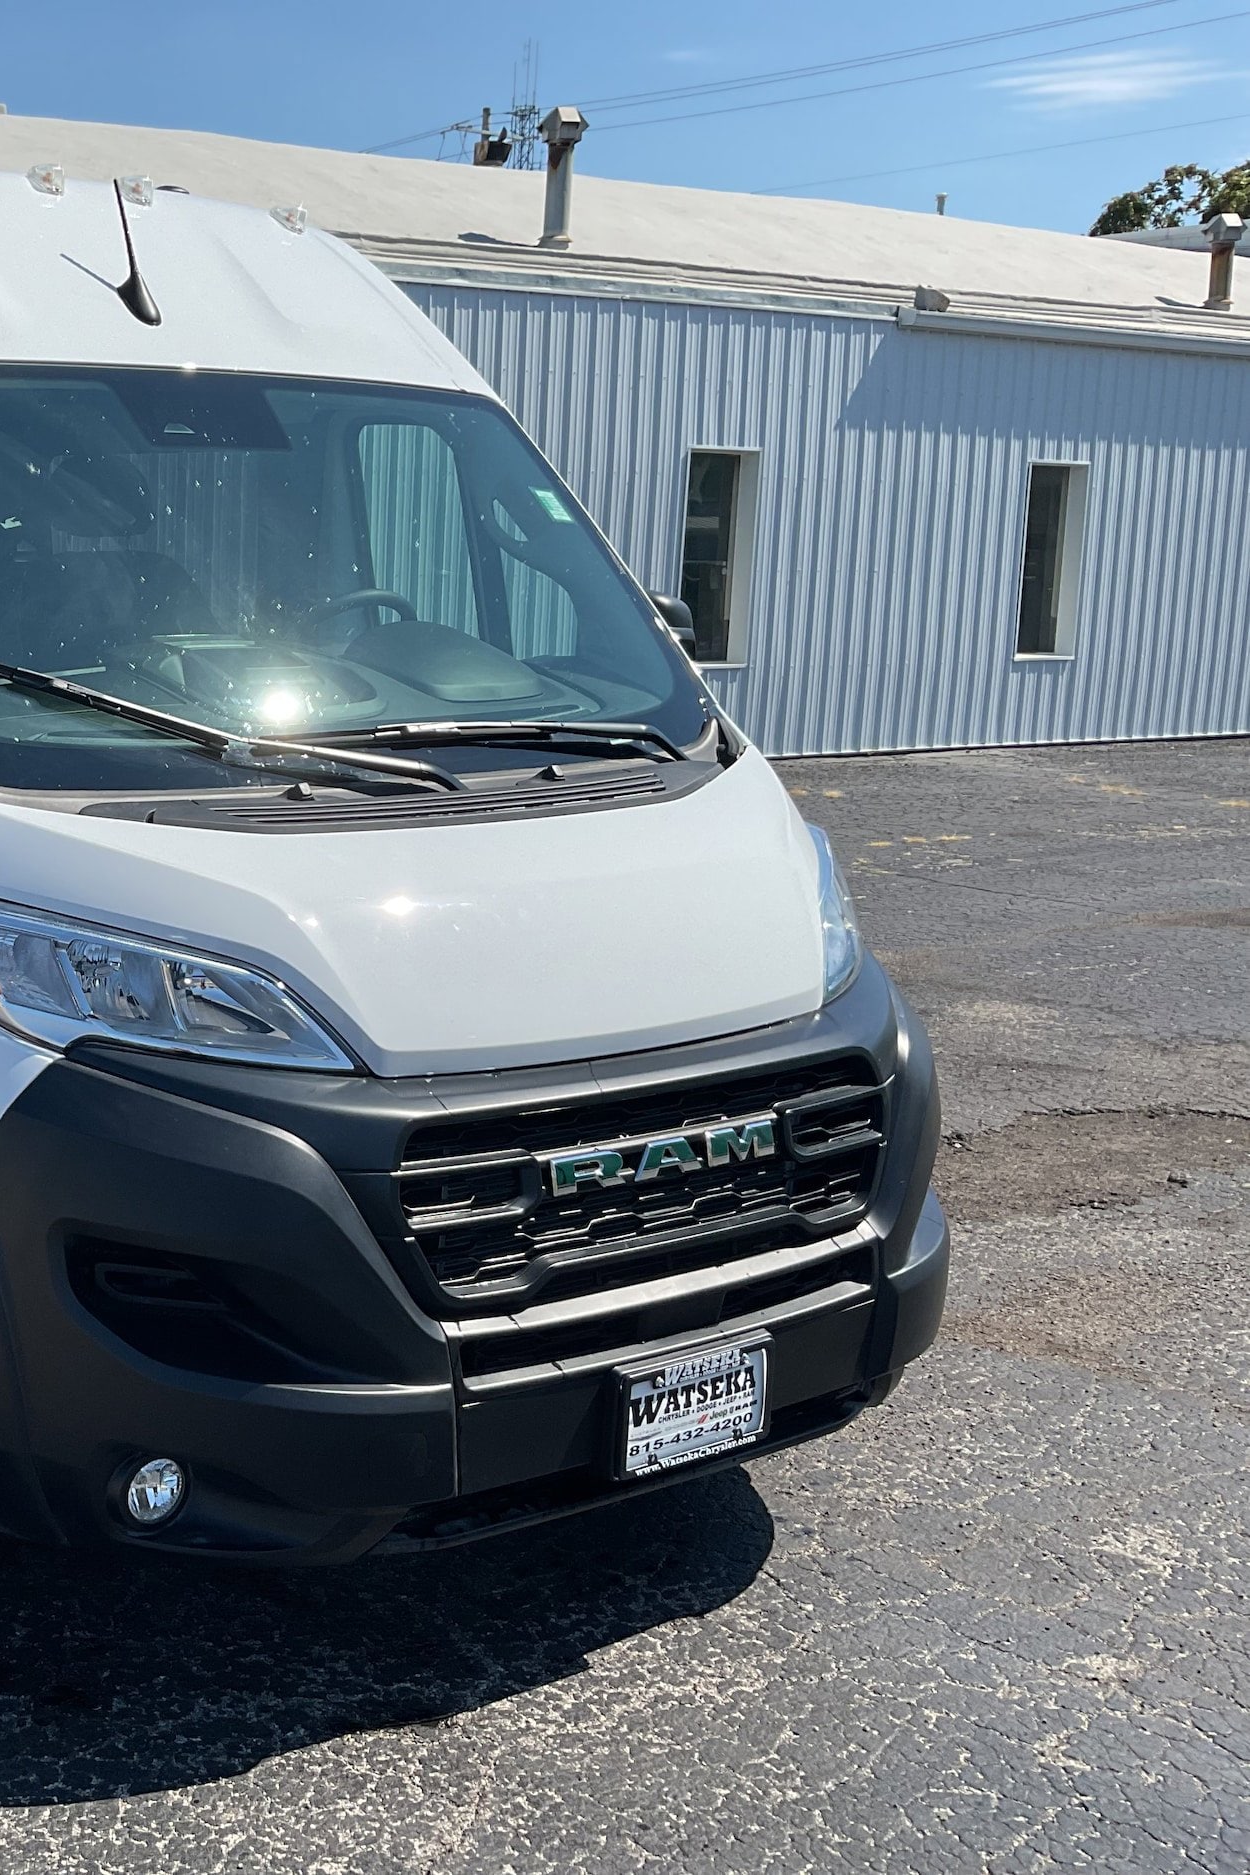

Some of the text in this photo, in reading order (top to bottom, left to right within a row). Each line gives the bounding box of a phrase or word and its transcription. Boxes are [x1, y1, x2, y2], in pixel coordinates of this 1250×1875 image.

[549, 1119, 776, 1198] RAM
[663, 1348, 742, 1386] WATSEKA
[629, 1365, 756, 1428] WATSEKA
[658, 1409, 691, 1424] CHRYSLER
[696, 1401, 718, 1413] DODGE
[723, 1396, 738, 1406] JEEP
[709, 1408, 728, 1420] Jeep
[629, 1412, 753, 1457] 815-432-4200
[635, 1435, 757, 1477] www.WatsekaChrysler.com
